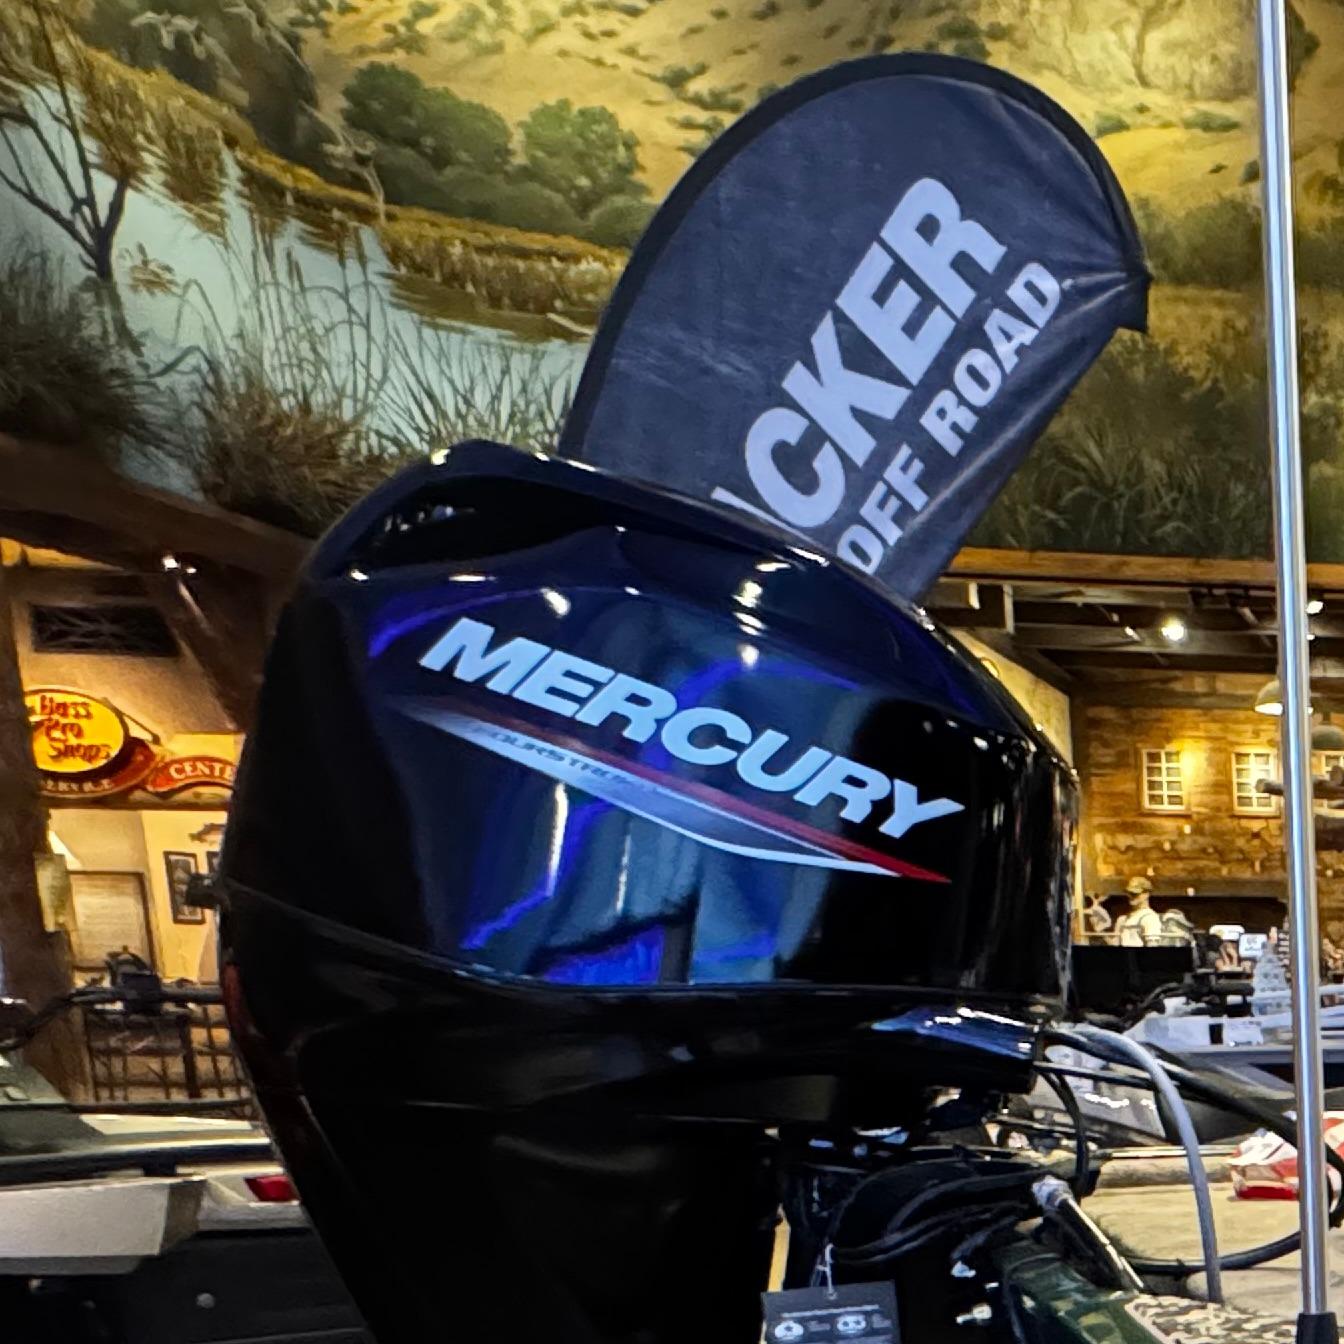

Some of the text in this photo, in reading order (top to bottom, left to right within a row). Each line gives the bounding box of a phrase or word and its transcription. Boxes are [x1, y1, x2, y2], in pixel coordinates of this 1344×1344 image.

[712, 177, 1007, 529] CKER
[836, 261, 1063, 576] OFF ROAD
[418, 616, 966, 839] MERCURY
